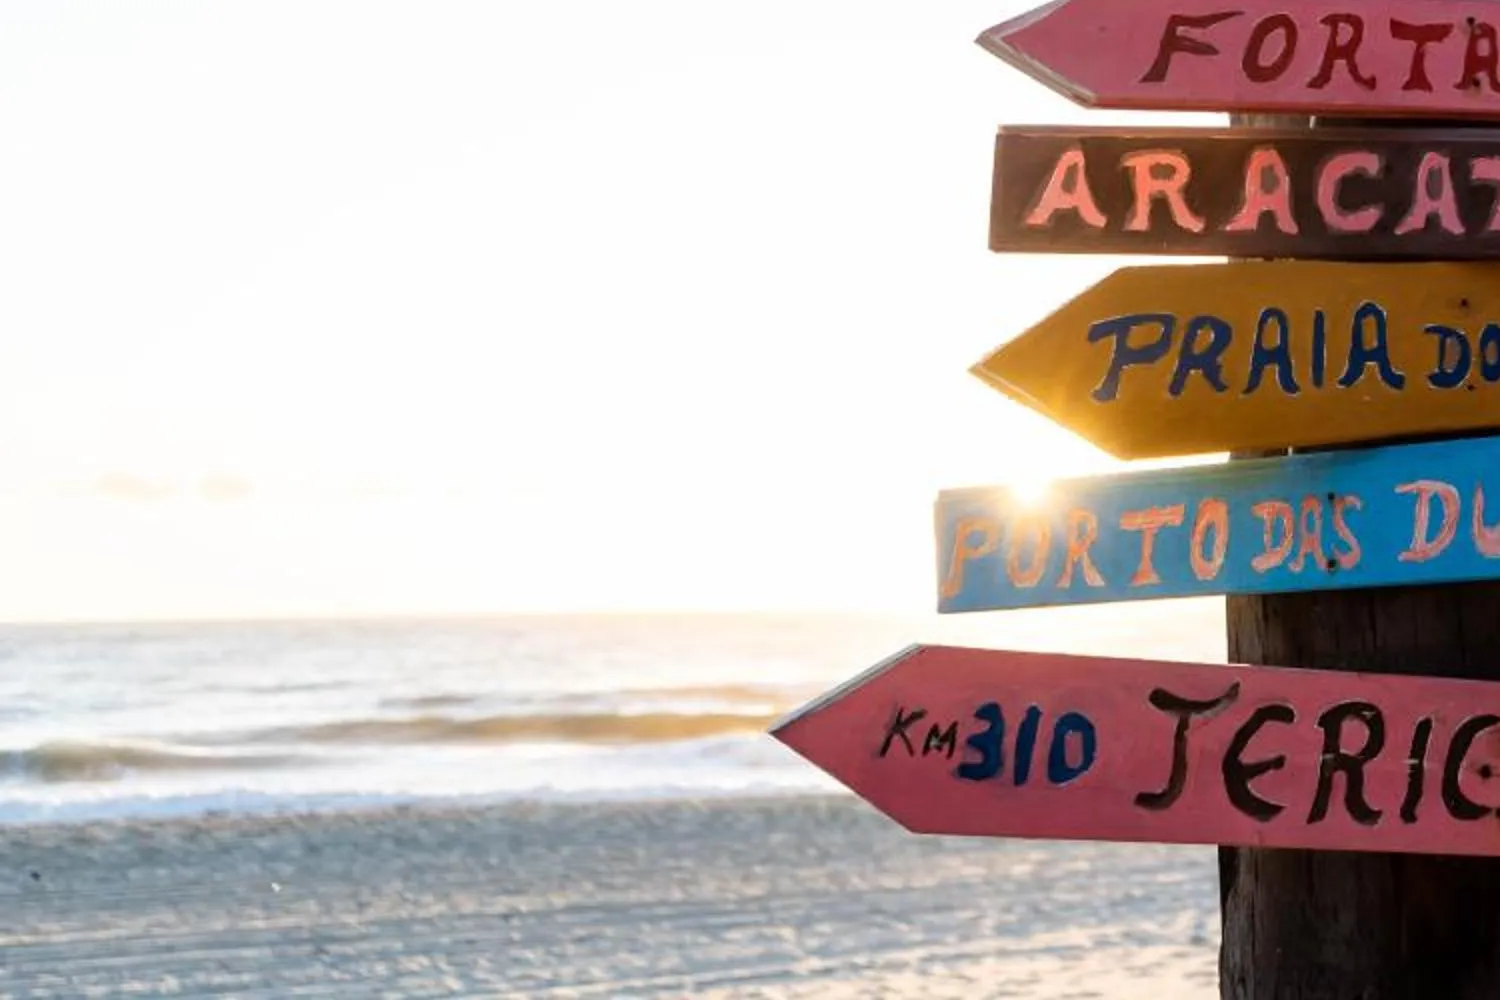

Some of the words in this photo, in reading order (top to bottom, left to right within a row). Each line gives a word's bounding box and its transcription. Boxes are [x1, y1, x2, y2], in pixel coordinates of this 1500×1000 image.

[1088, 302, 1402, 404] PRAIA
[940, 496, 1229, 598] PORTO
[1250, 492, 1364, 574] DAS
